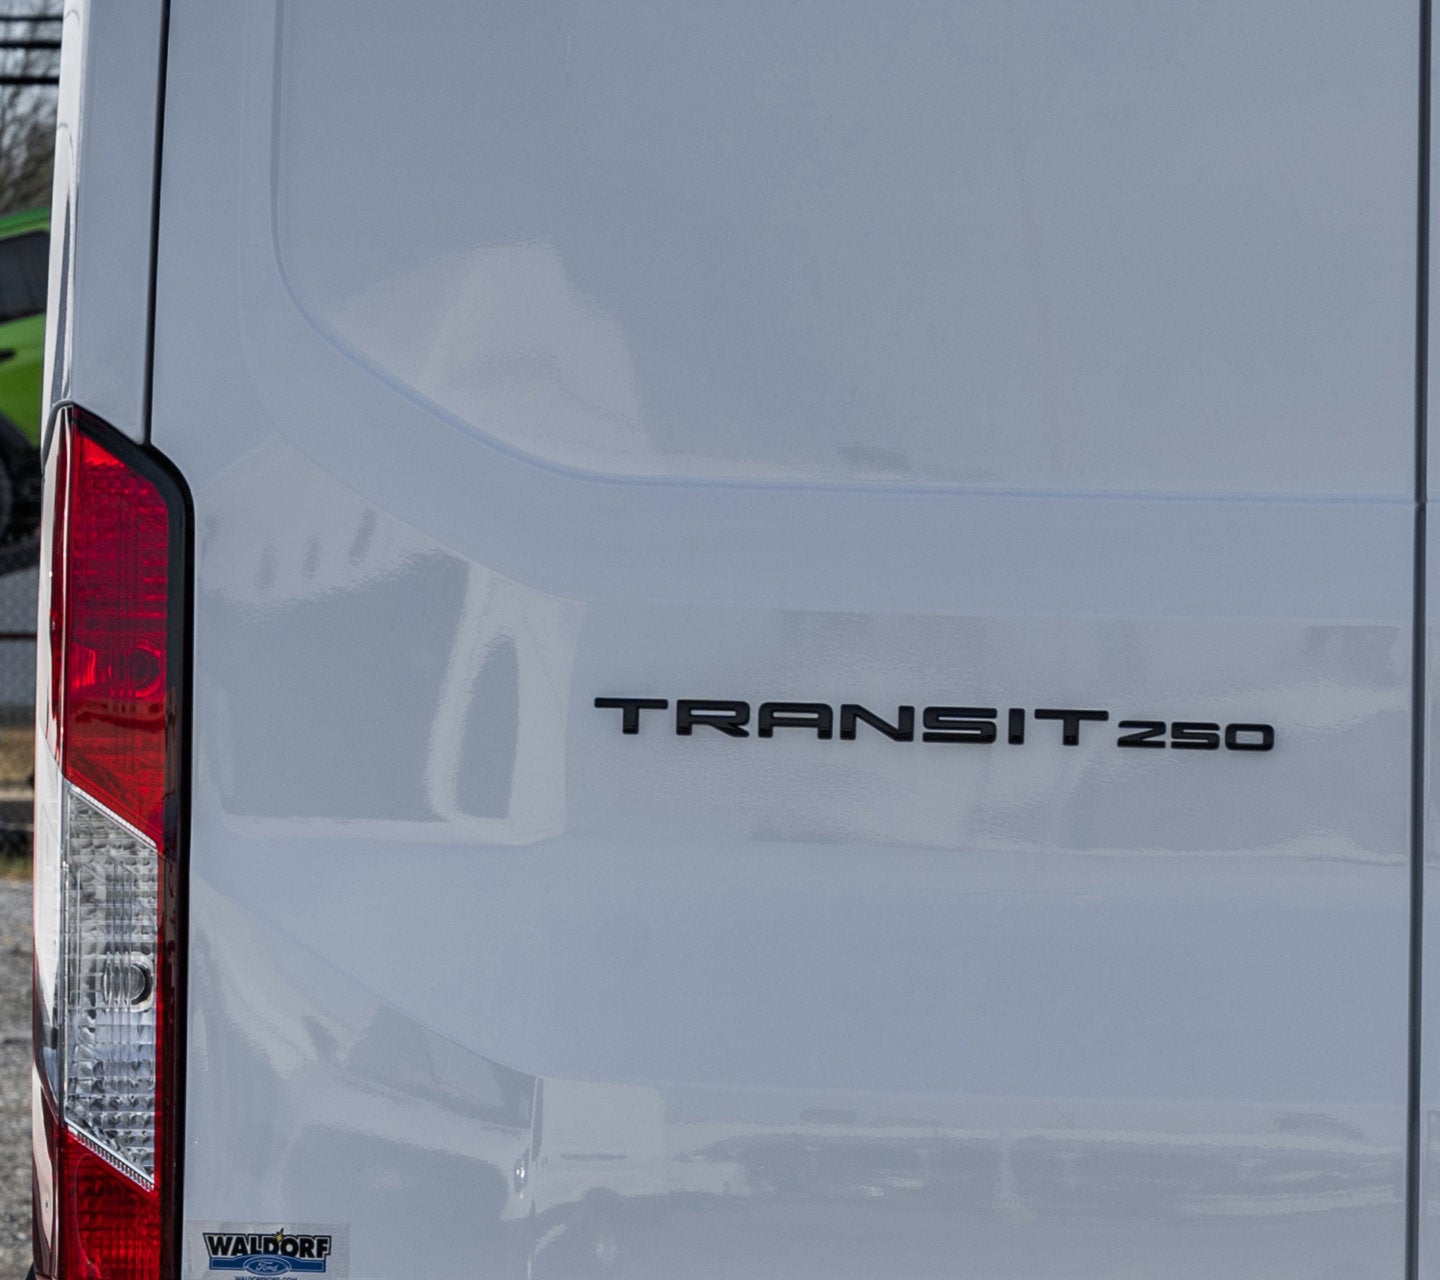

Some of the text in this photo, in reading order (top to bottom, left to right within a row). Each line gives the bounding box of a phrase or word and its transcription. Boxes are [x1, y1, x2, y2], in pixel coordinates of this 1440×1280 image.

[594, 697, 1275, 753] TRANSIT 250
[205, 1233, 330, 1259] WALDORF
